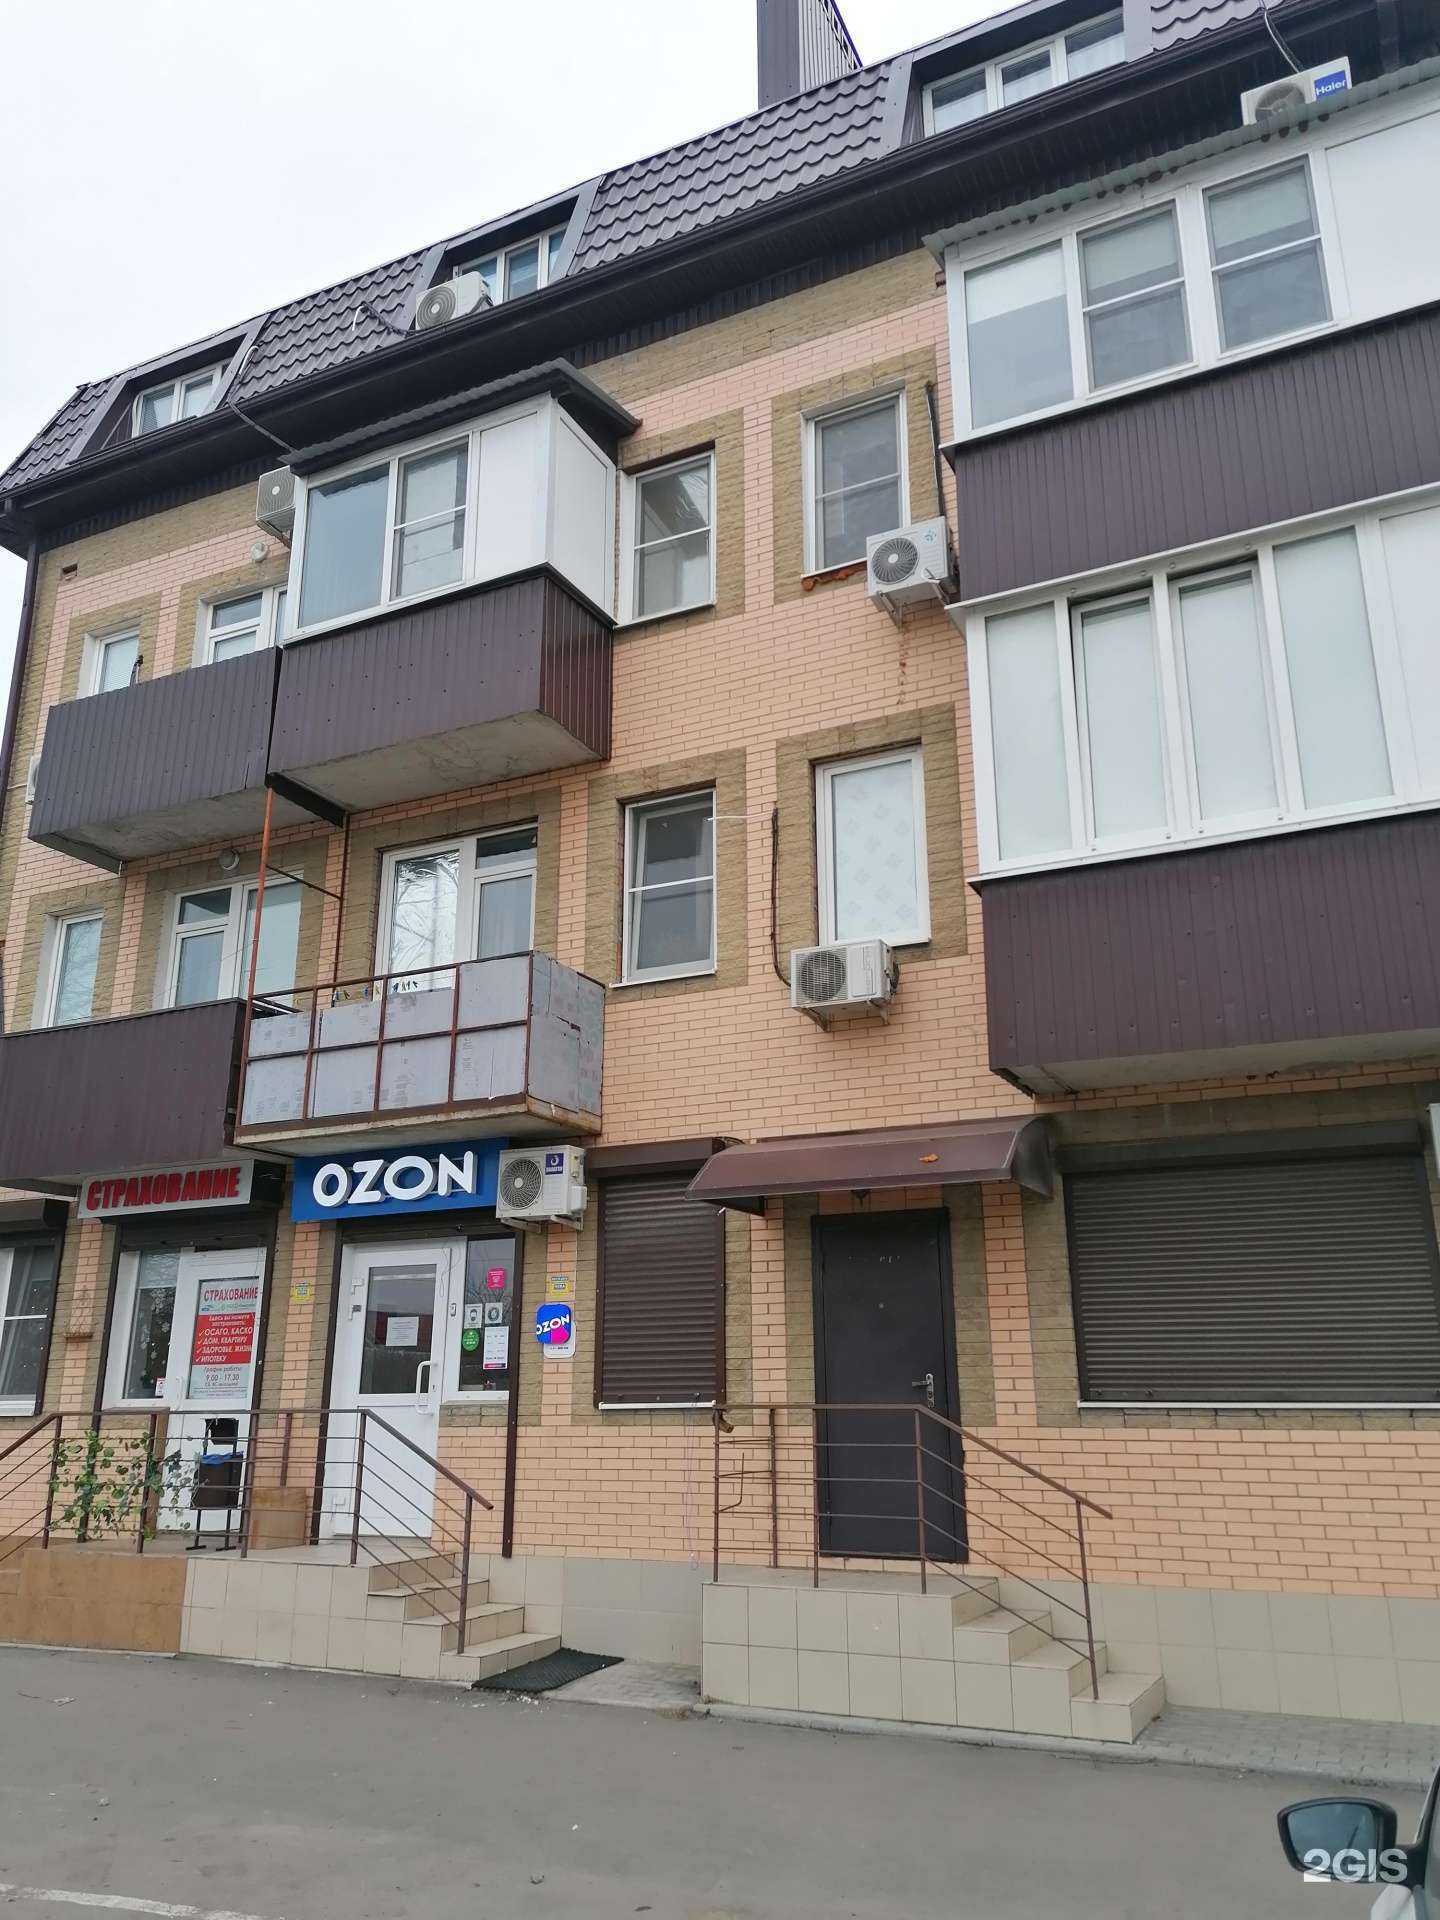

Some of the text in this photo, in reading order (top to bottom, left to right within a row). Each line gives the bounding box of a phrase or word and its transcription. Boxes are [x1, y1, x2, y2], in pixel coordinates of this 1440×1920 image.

[1315, 80, 1346, 96] Haier
[86, 1166, 241, 1211] СТРАХОВАНИЕ
[312, 1150, 478, 1208] OZON
[204, 1287, 258, 1302] СТРАХОВАНИЕ
